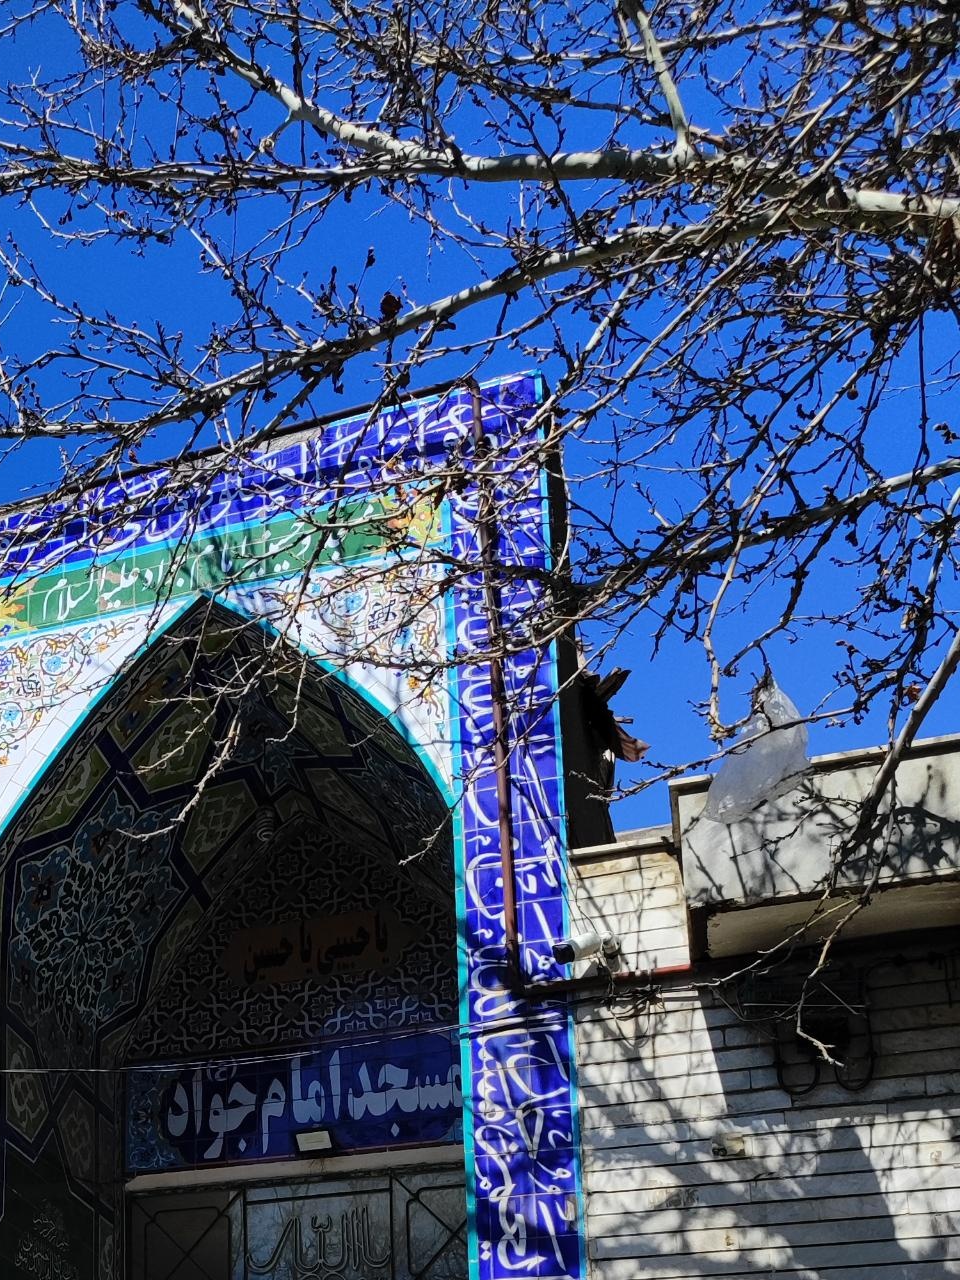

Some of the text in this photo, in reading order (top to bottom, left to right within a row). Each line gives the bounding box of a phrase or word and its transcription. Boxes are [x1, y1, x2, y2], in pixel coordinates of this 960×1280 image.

[43, 566, 107, 621] السلام
[167, 1067, 258, 1160] جواد
[261, 1048, 341, 1155] امام
[346, 1060, 462, 1138] مسجد
